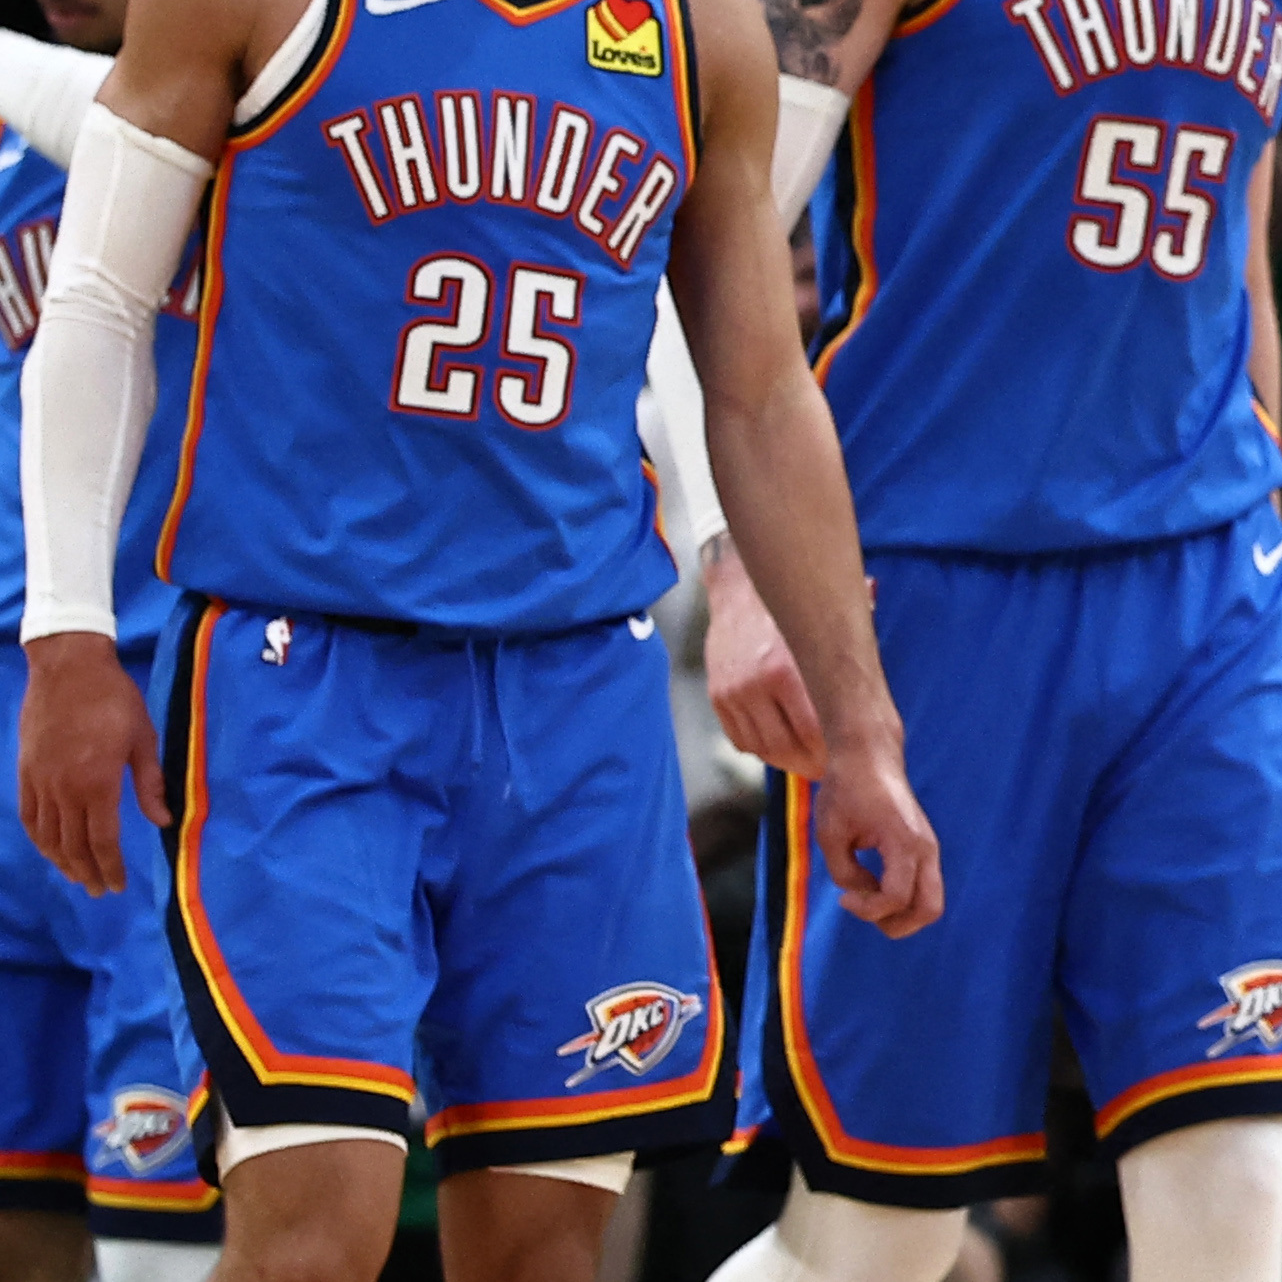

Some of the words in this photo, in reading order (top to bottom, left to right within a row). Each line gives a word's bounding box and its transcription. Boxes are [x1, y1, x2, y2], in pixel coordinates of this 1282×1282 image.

[321, 90, 676, 270] THUNDER
[1067, 113, 1237, 282] 55
[389, 252, 586, 431] 25
[593, 999, 667, 1064] OKC
